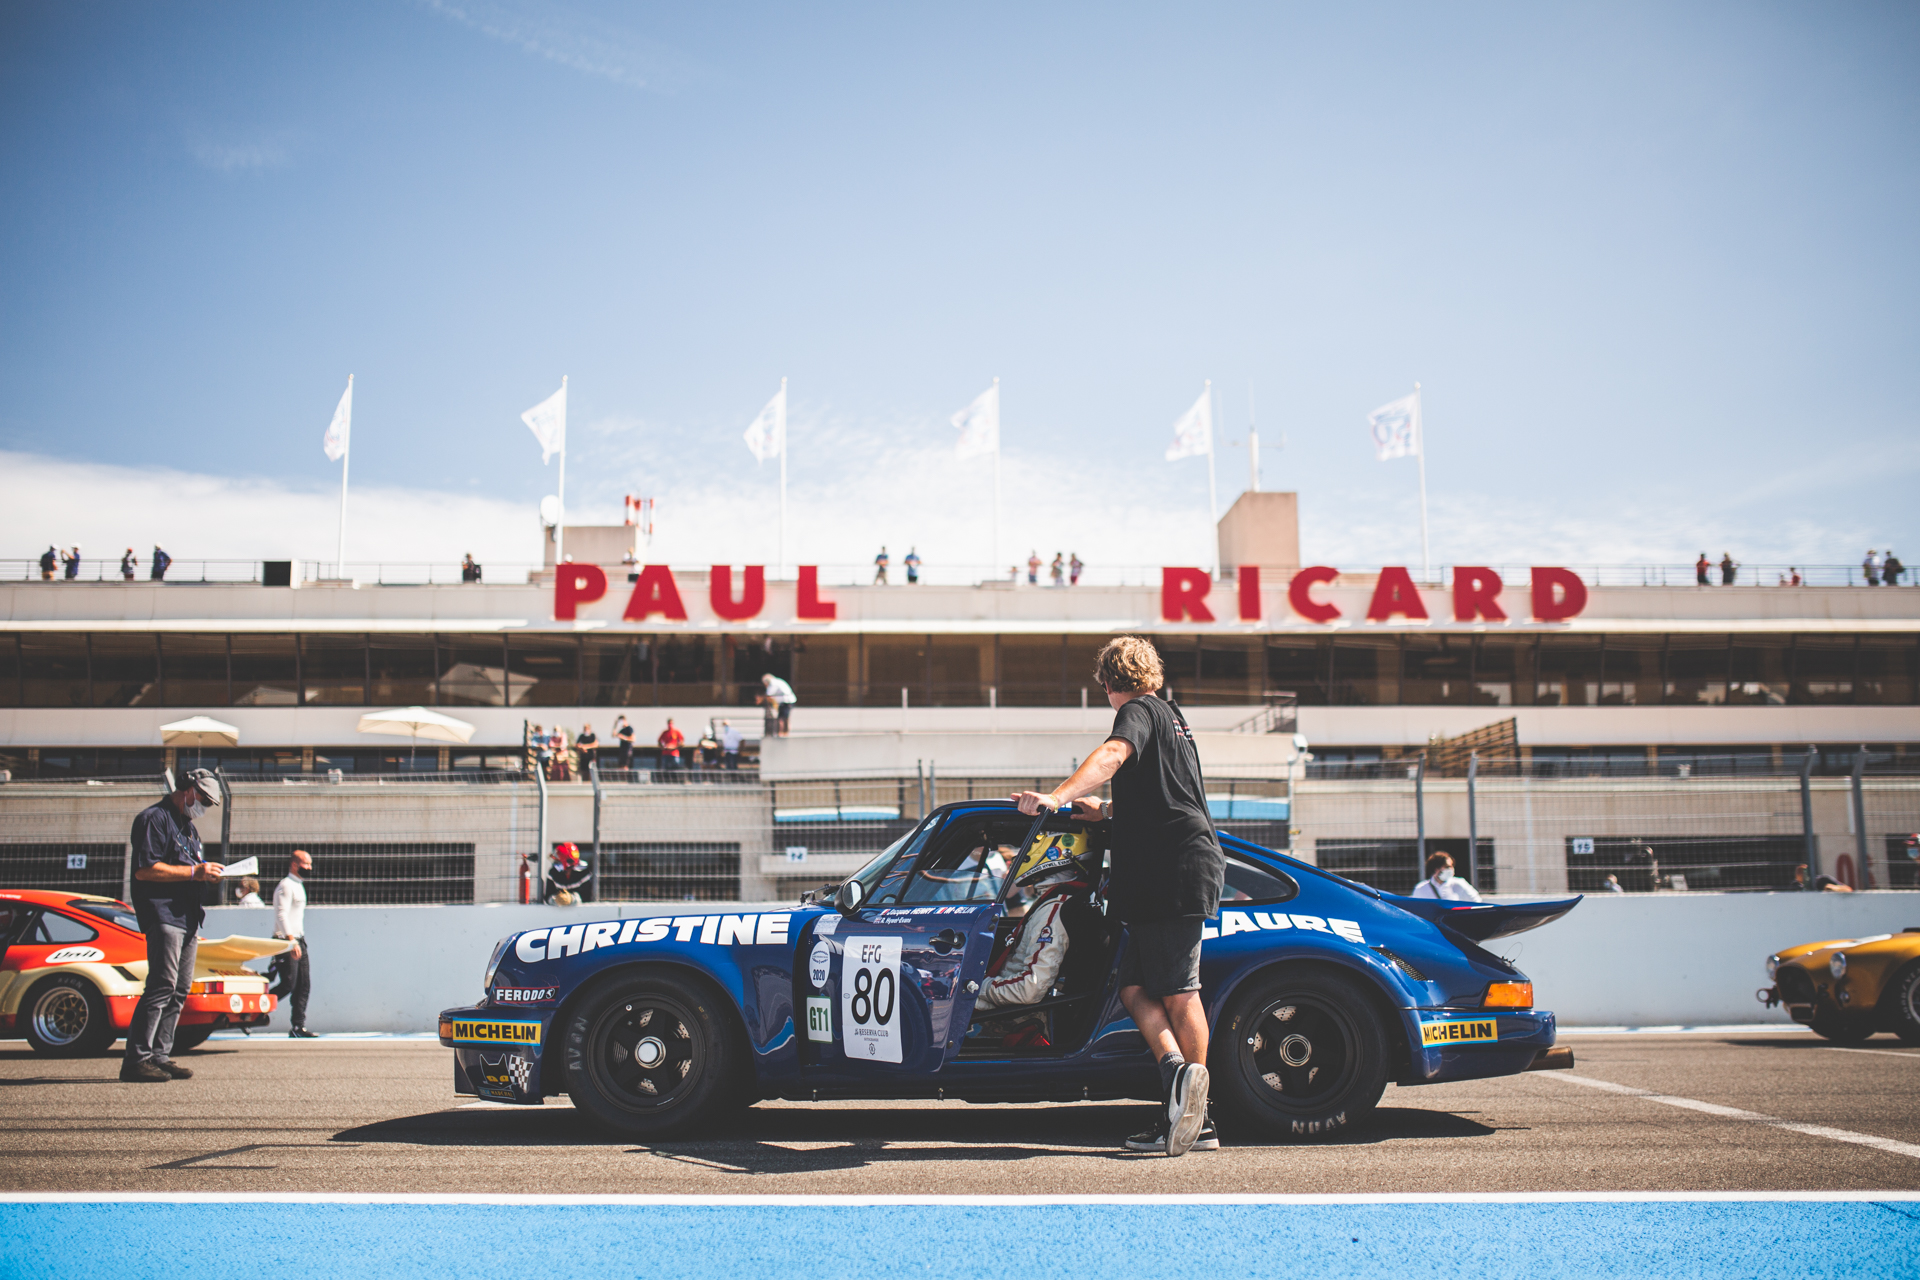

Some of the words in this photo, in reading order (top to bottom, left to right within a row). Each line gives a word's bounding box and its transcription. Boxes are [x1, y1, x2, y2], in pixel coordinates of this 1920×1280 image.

[555, 564, 836, 621] PAUL
[1162, 566, 1588, 622] RICARD
[516, 914, 792, 963] CHRISTINE
[861, 944, 882, 964] EFG
[812, 968, 826, 981] 2020
[496, 989, 545, 1001] FERODO
[851, 967, 895, 1026] 80
[809, 1006, 829, 1032] GT1
[455, 1023, 536, 1041] MICHELIN
[568, 1016, 588, 1071] AVON
[1423, 1022, 1492, 1042] MICHELIN
